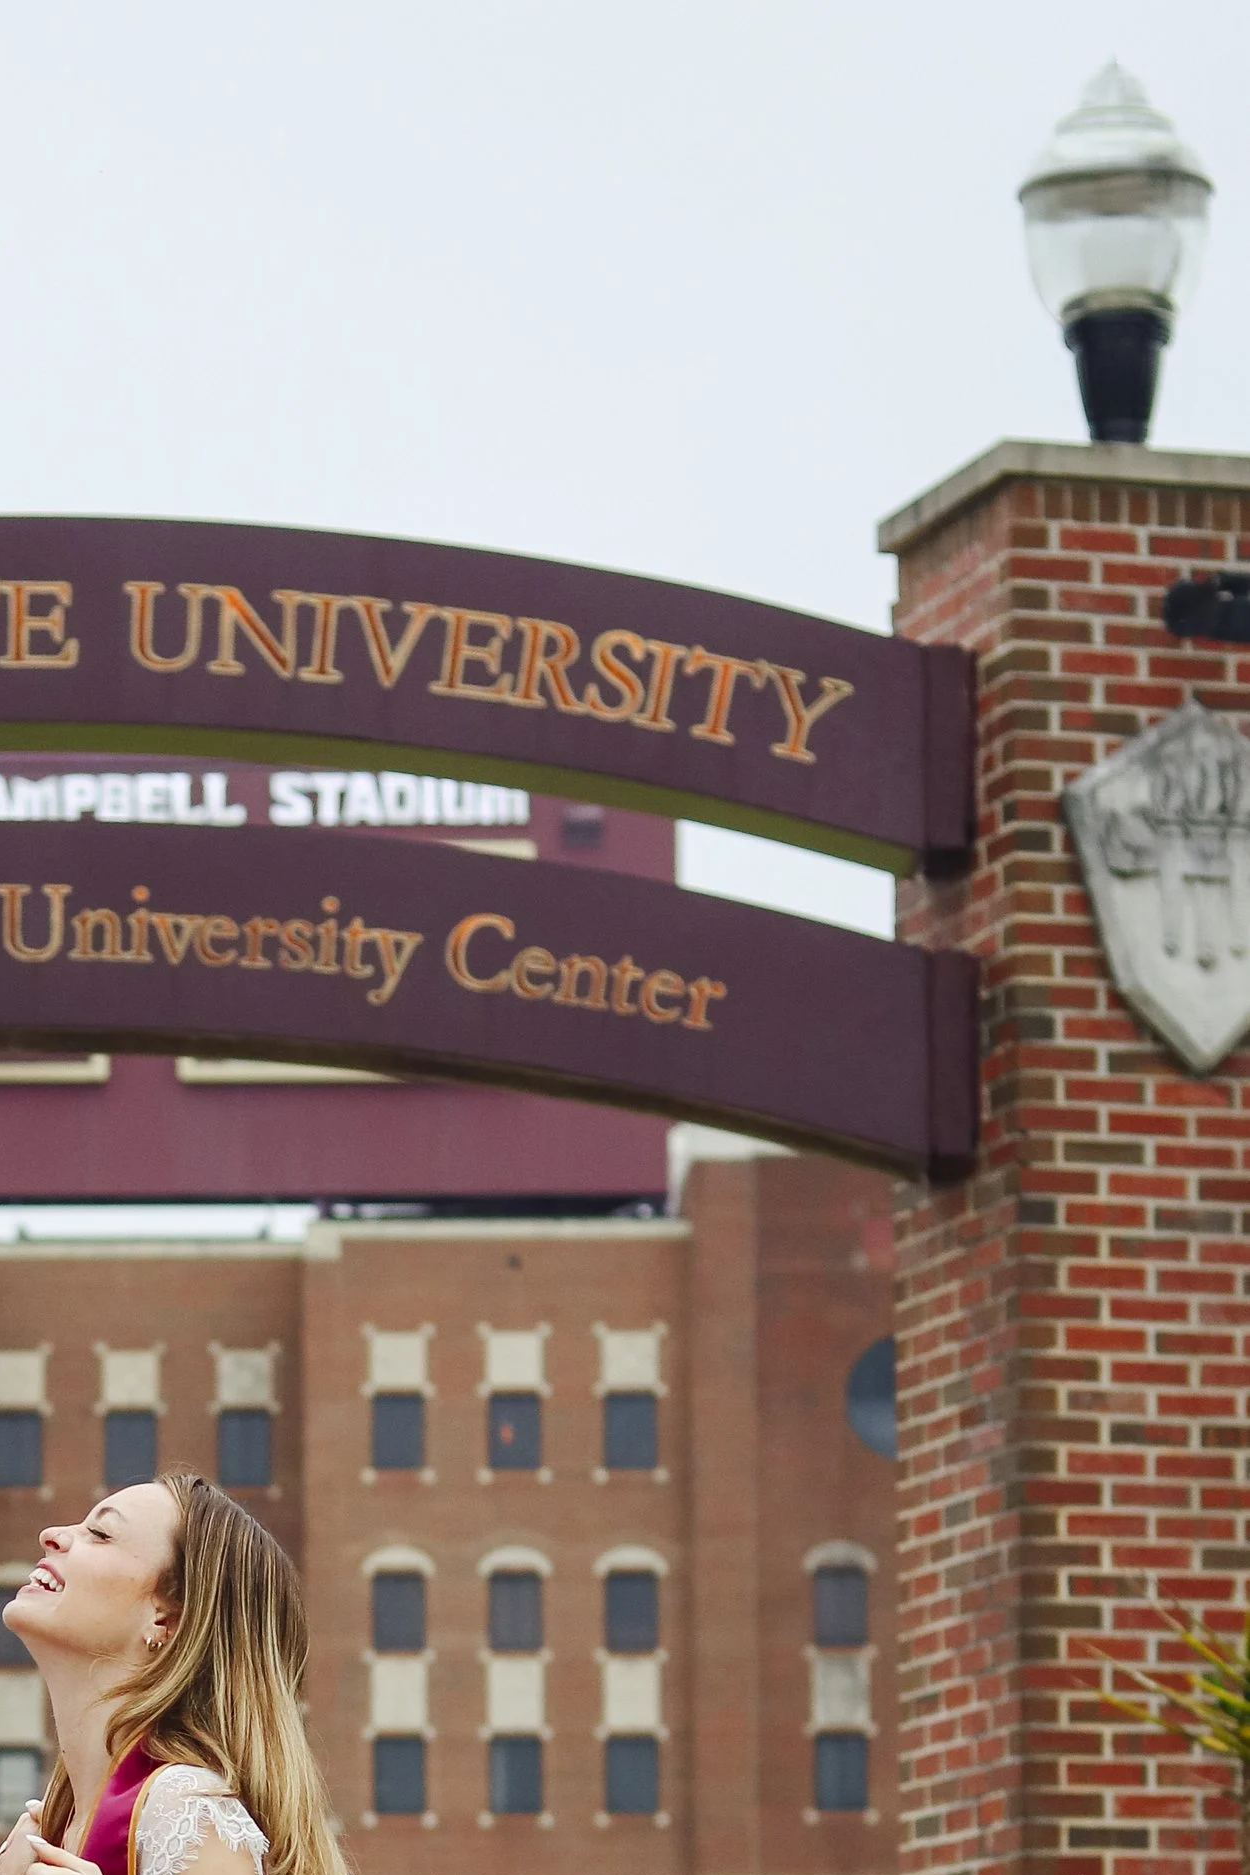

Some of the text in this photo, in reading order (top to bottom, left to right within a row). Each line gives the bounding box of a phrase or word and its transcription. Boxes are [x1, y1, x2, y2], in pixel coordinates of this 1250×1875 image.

[124, 581, 853, 764] UNIVERSITY
[269, 771, 530, 826] STADIUM
[445, 913, 726, 1030] Center
